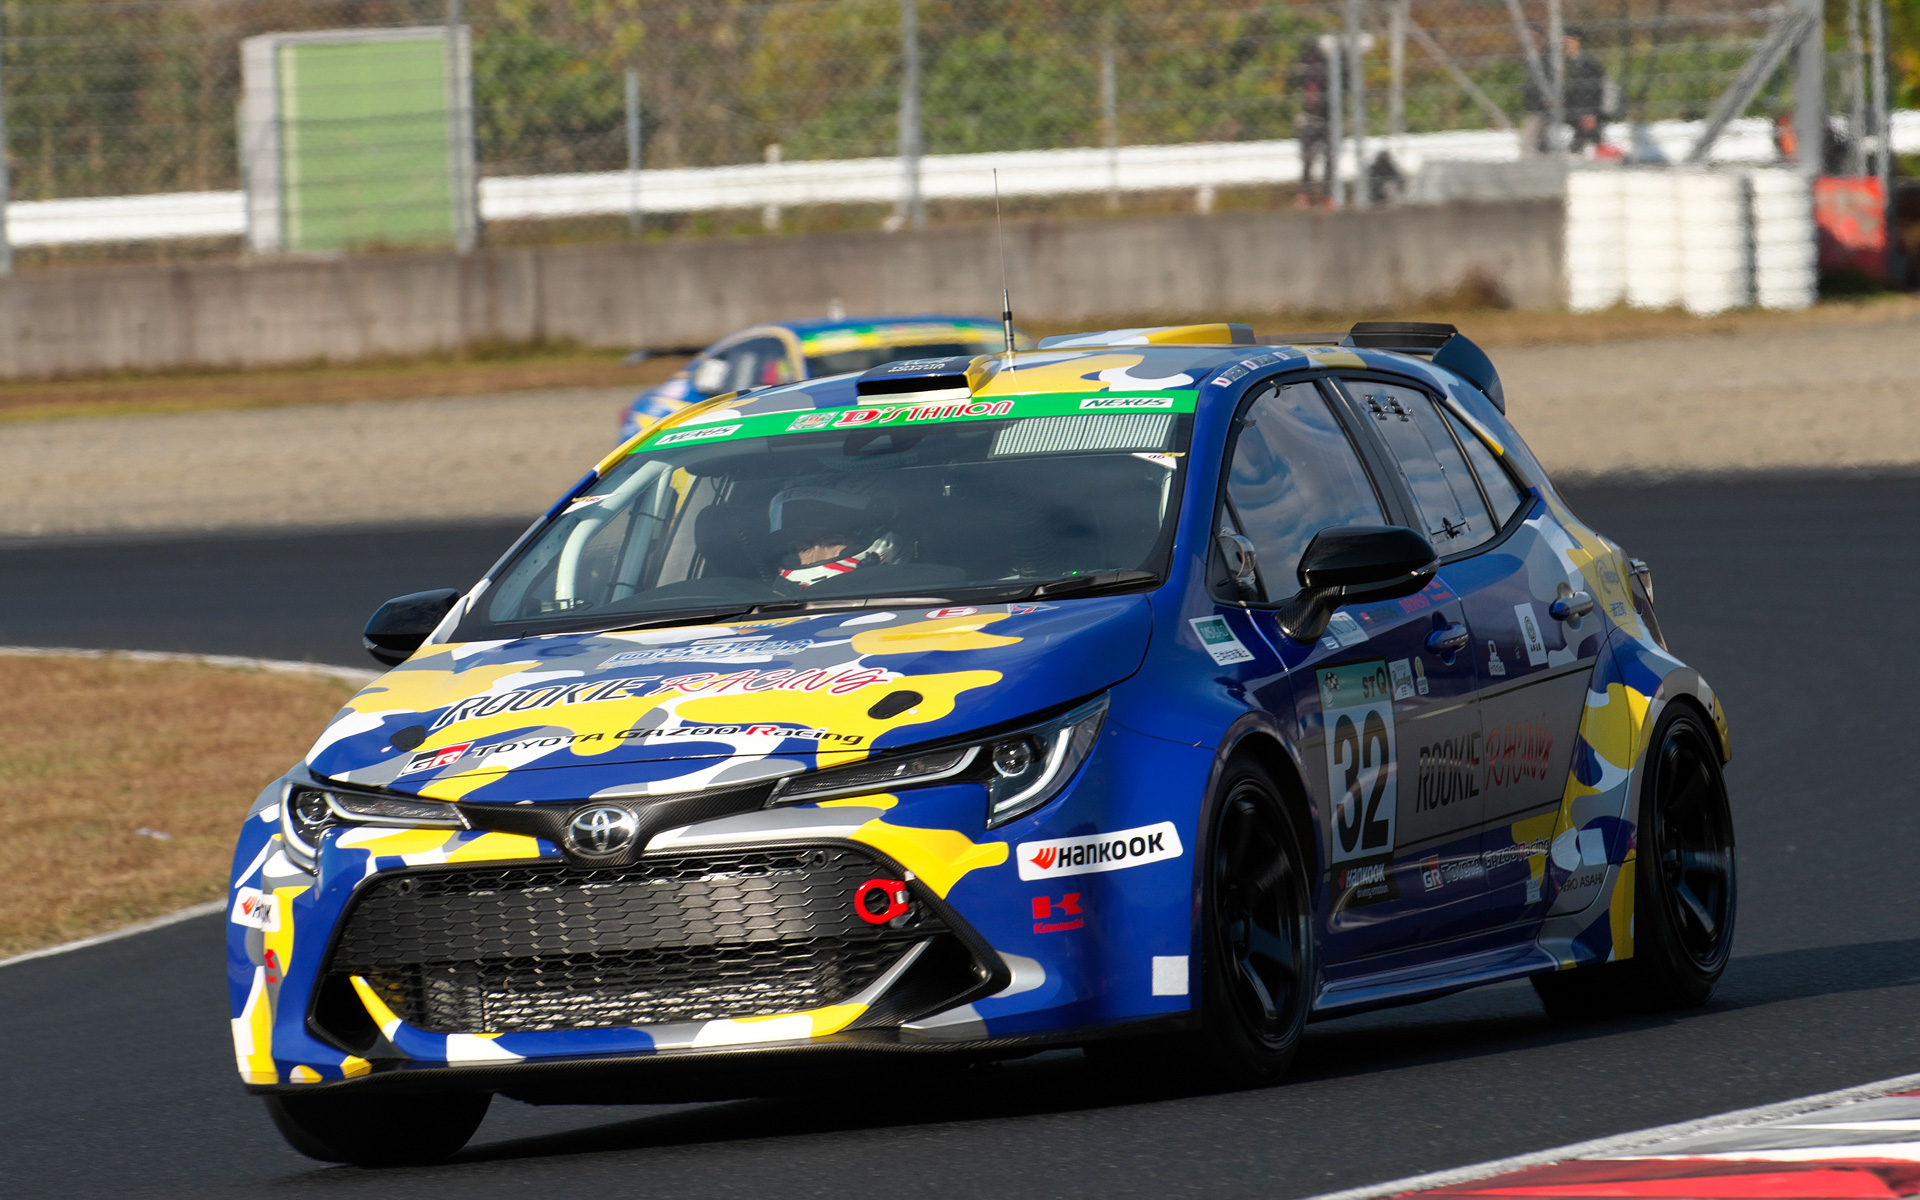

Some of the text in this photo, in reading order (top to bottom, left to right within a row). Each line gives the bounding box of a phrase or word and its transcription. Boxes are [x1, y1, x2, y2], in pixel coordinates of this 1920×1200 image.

[1085, 399, 1169, 408] NEXUS
[434, 669, 889, 728] ROOKIE RACING
[473, 733, 605, 757] TOYOTA
[614, 726, 738, 740] GAZOO
[745, 725, 865, 746] Racing
[1416, 712, 1553, 813] ROOKIE RACING
[1334, 710, 1390, 853] 32
[1422, 868, 1443, 889] GR
[1441, 859, 1482, 884] TOYOTA
[1517, 837, 1550, 863] Racing
[1034, 918, 1084, 934] Kawasaki
